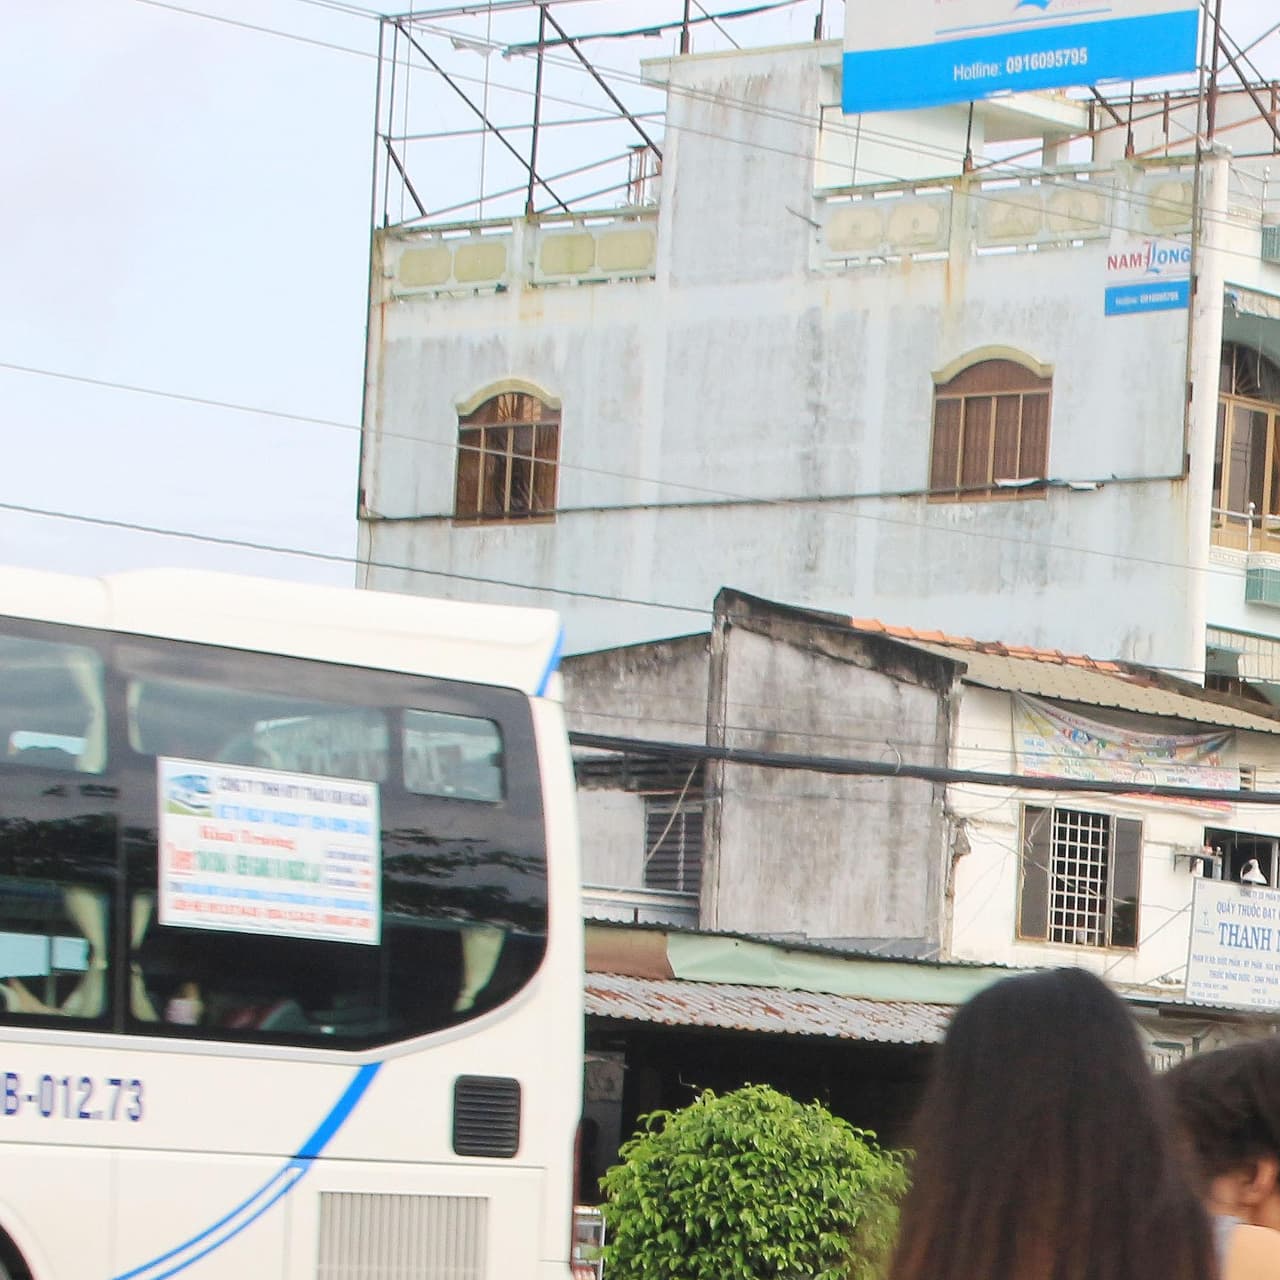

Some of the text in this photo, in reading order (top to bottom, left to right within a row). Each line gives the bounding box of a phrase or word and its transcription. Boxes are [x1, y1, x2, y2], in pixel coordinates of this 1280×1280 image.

[953, 47, 1088, 81] Hotline: 0916095795
[1107, 253, 1142, 270] NAM
[1218, 922, 1272, 951] THANH
